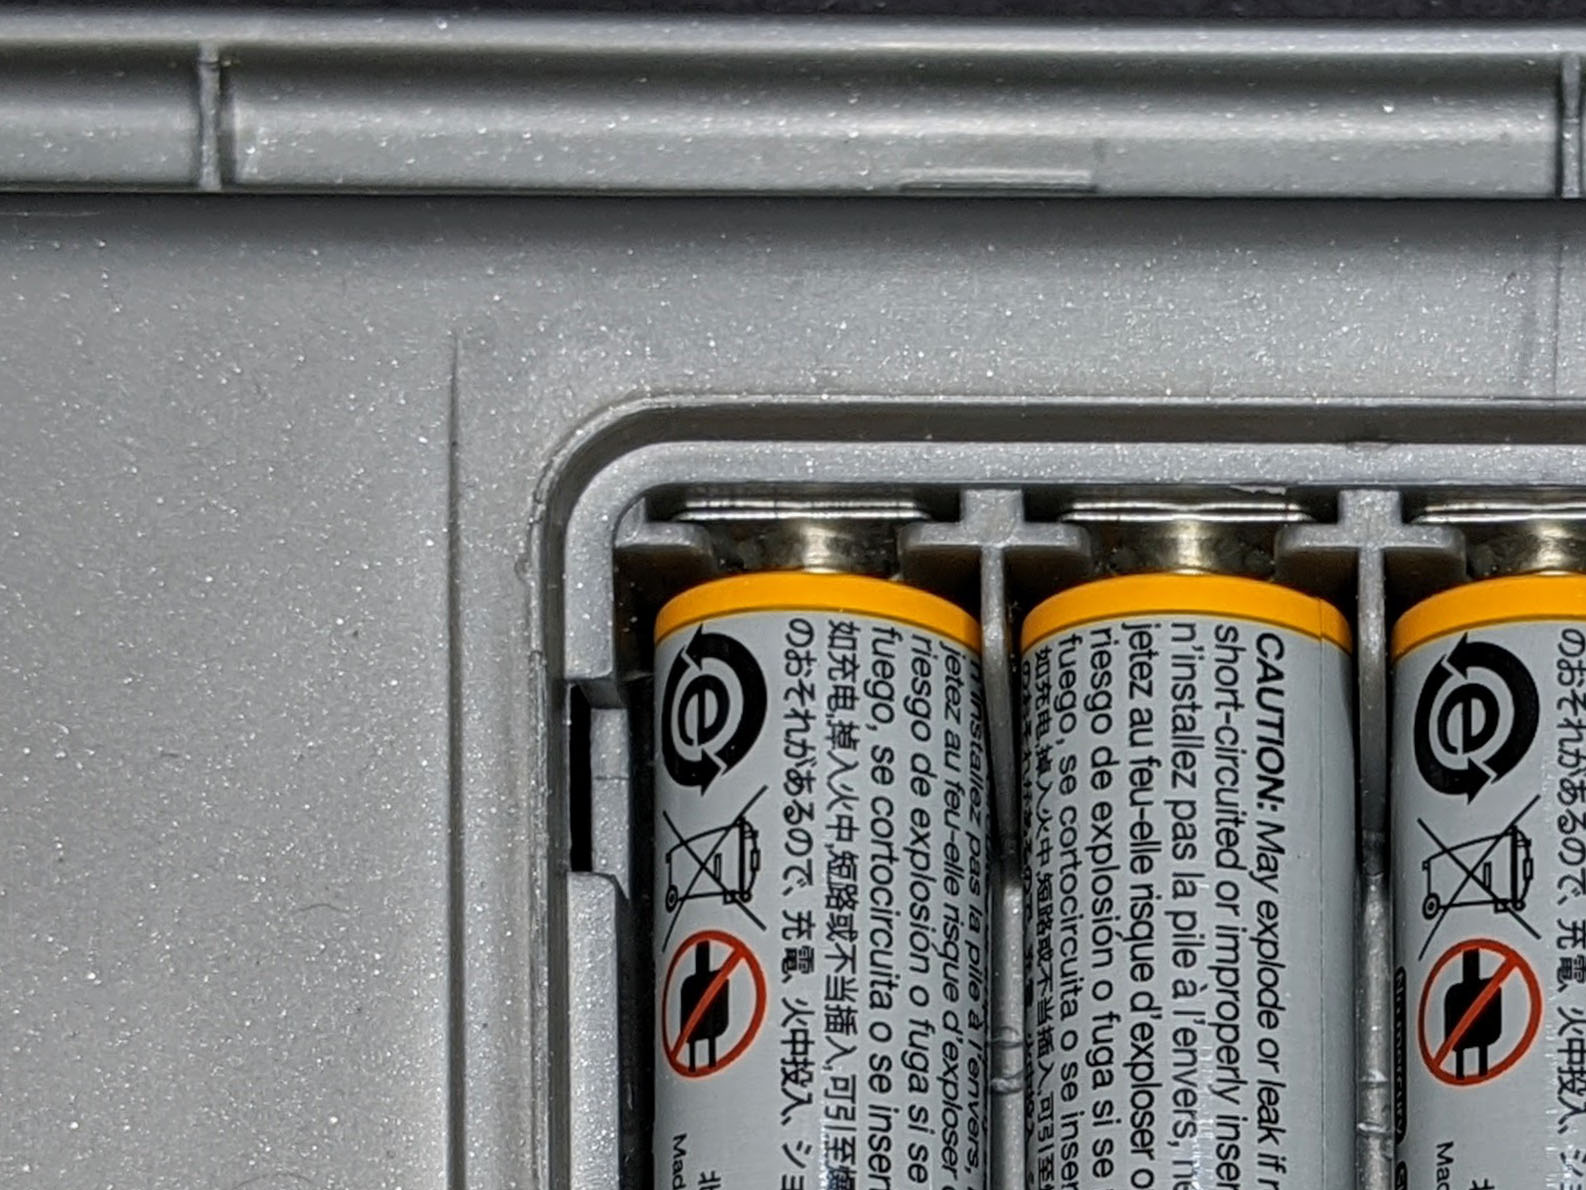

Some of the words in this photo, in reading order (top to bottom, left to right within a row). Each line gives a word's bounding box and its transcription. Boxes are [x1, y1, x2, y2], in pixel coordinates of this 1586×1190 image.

[862, 626, 904, 732] fuego,
[902, 633, 939, 743] riesgo
[938, 641, 965, 726] jetez
[1052, 632, 1084, 746] fuego,
[1082, 626, 1120, 735] riesgo
[1120, 622, 1162, 701] jetez
[943, 728, 962, 774] au
[1128, 707, 1154, 748] au
[1213, 623, 1250, 875] short-circuited
[1254, 632, 1286, 813] CAUTION:
[870, 744, 895, 786] se
[909, 752, 939, 798] de
[1058, 753, 1078, 797] se
[1089, 745, 1121, 791] de
[942, 778, 966, 897] feu-elle
[1128, 754, 1163, 875] feu-elle
[902, 807, 938, 975] explosión
[1083, 800, 1127, 969] explosión
[1247, 819, 1286, 895] May
[868, 795, 902, 1011] cortocircuita
[1058, 804, 1085, 1022] cortocircuita
[1119, 883, 1163, 983] risque
[1214, 880, 1241, 917] or
[932, 901, 965, 1004] risque
[1091, 979, 1114, 1002] o
[1248, 899, 1287, 1031] explode
[868, 1021, 893, 1044] o
[908, 984, 930, 1008] o
[1208, 924, 1249, 1106] improperly
[867, 1052, 893, 1095] se
[900, 1018, 937, 1095] fuga
[1059, 1029, 1079, 1052] o
[1084, 1010, 1122, 1091] fuga
[1121, 990, 1164, 1161] d'exploser
[1256, 1037, 1280, 1075] or
[907, 1103, 936, 1136] si
[935, 1009, 964, 1182] d'exploser
[1059, 1061, 1079, 1103] se
[1091, 1099, 1123, 1128] si
[1256, 1078, 1287, 1146] leak
[906, 1142, 930, 1184] se
[1091, 1137, 1115, 1179] se
[1256, 1152, 1288, 1175] if
